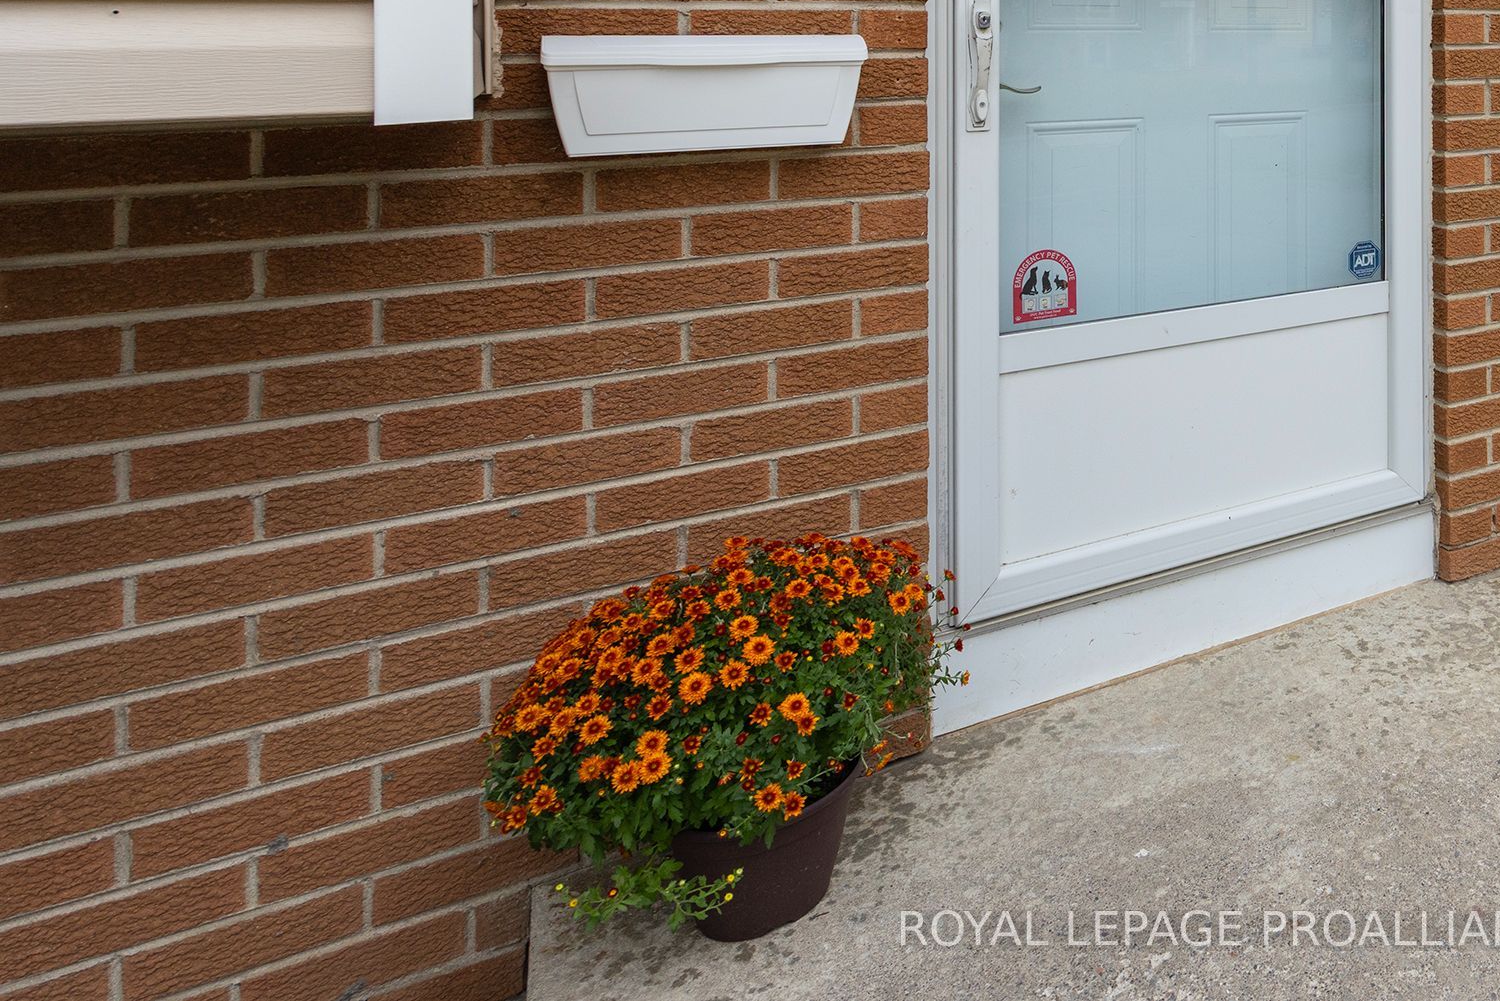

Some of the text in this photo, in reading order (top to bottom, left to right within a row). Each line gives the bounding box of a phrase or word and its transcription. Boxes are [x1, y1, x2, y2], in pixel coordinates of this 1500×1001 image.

[1014, 251, 1076, 288] EMERGENCY PET RESCUE
[1354, 253, 1375, 268] ADT
